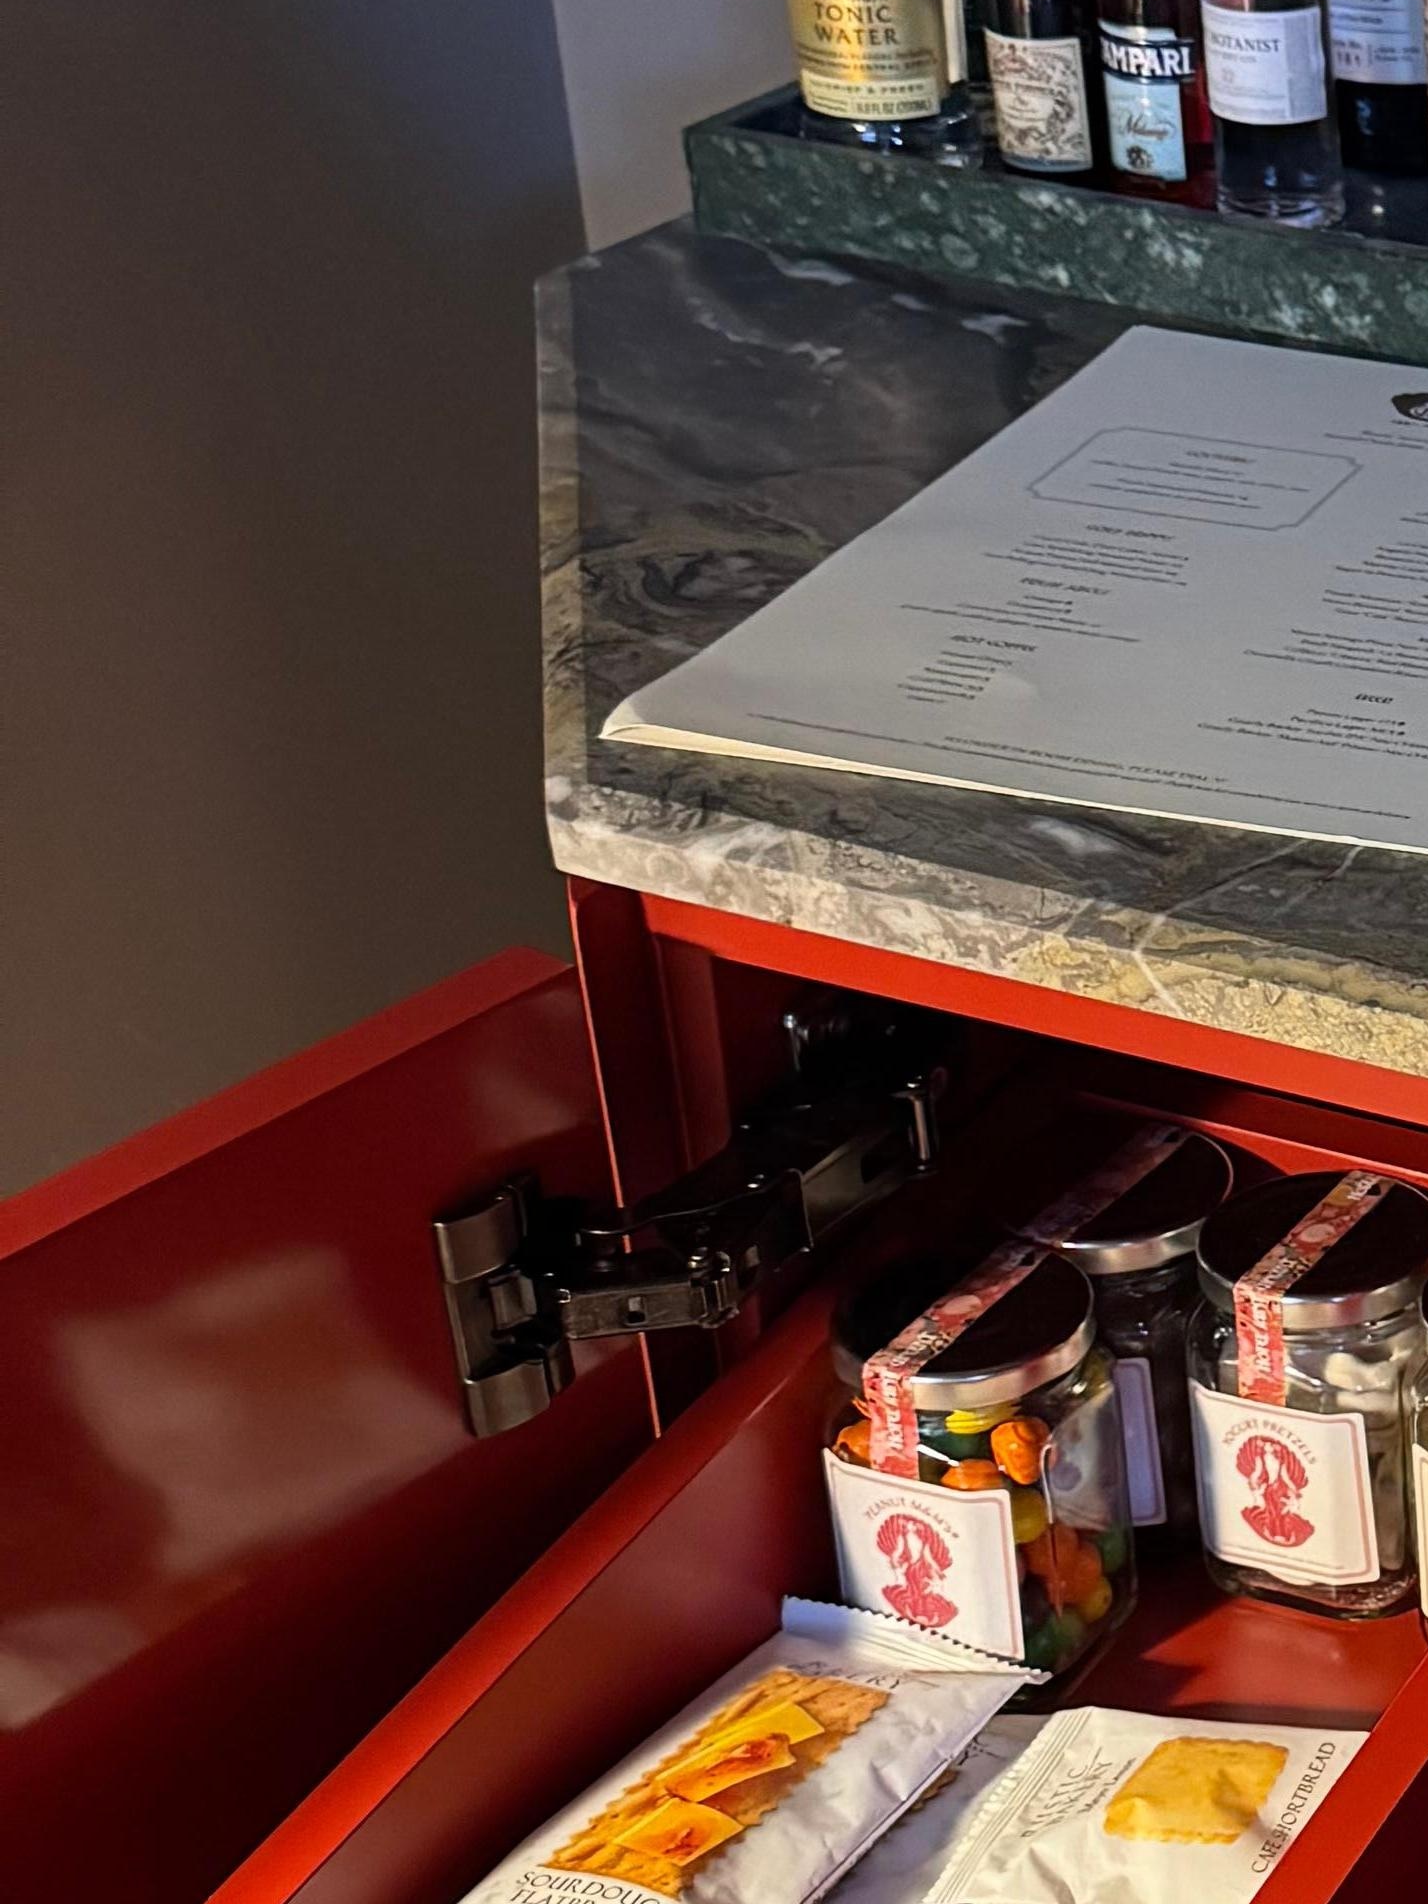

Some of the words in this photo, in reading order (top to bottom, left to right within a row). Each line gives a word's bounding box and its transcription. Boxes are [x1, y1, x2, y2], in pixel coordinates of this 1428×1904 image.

[814, 3, 892, 24] TONIC
[815, 24, 897, 46] WATER
[1262, 1418, 1319, 1466] PRETZELS
